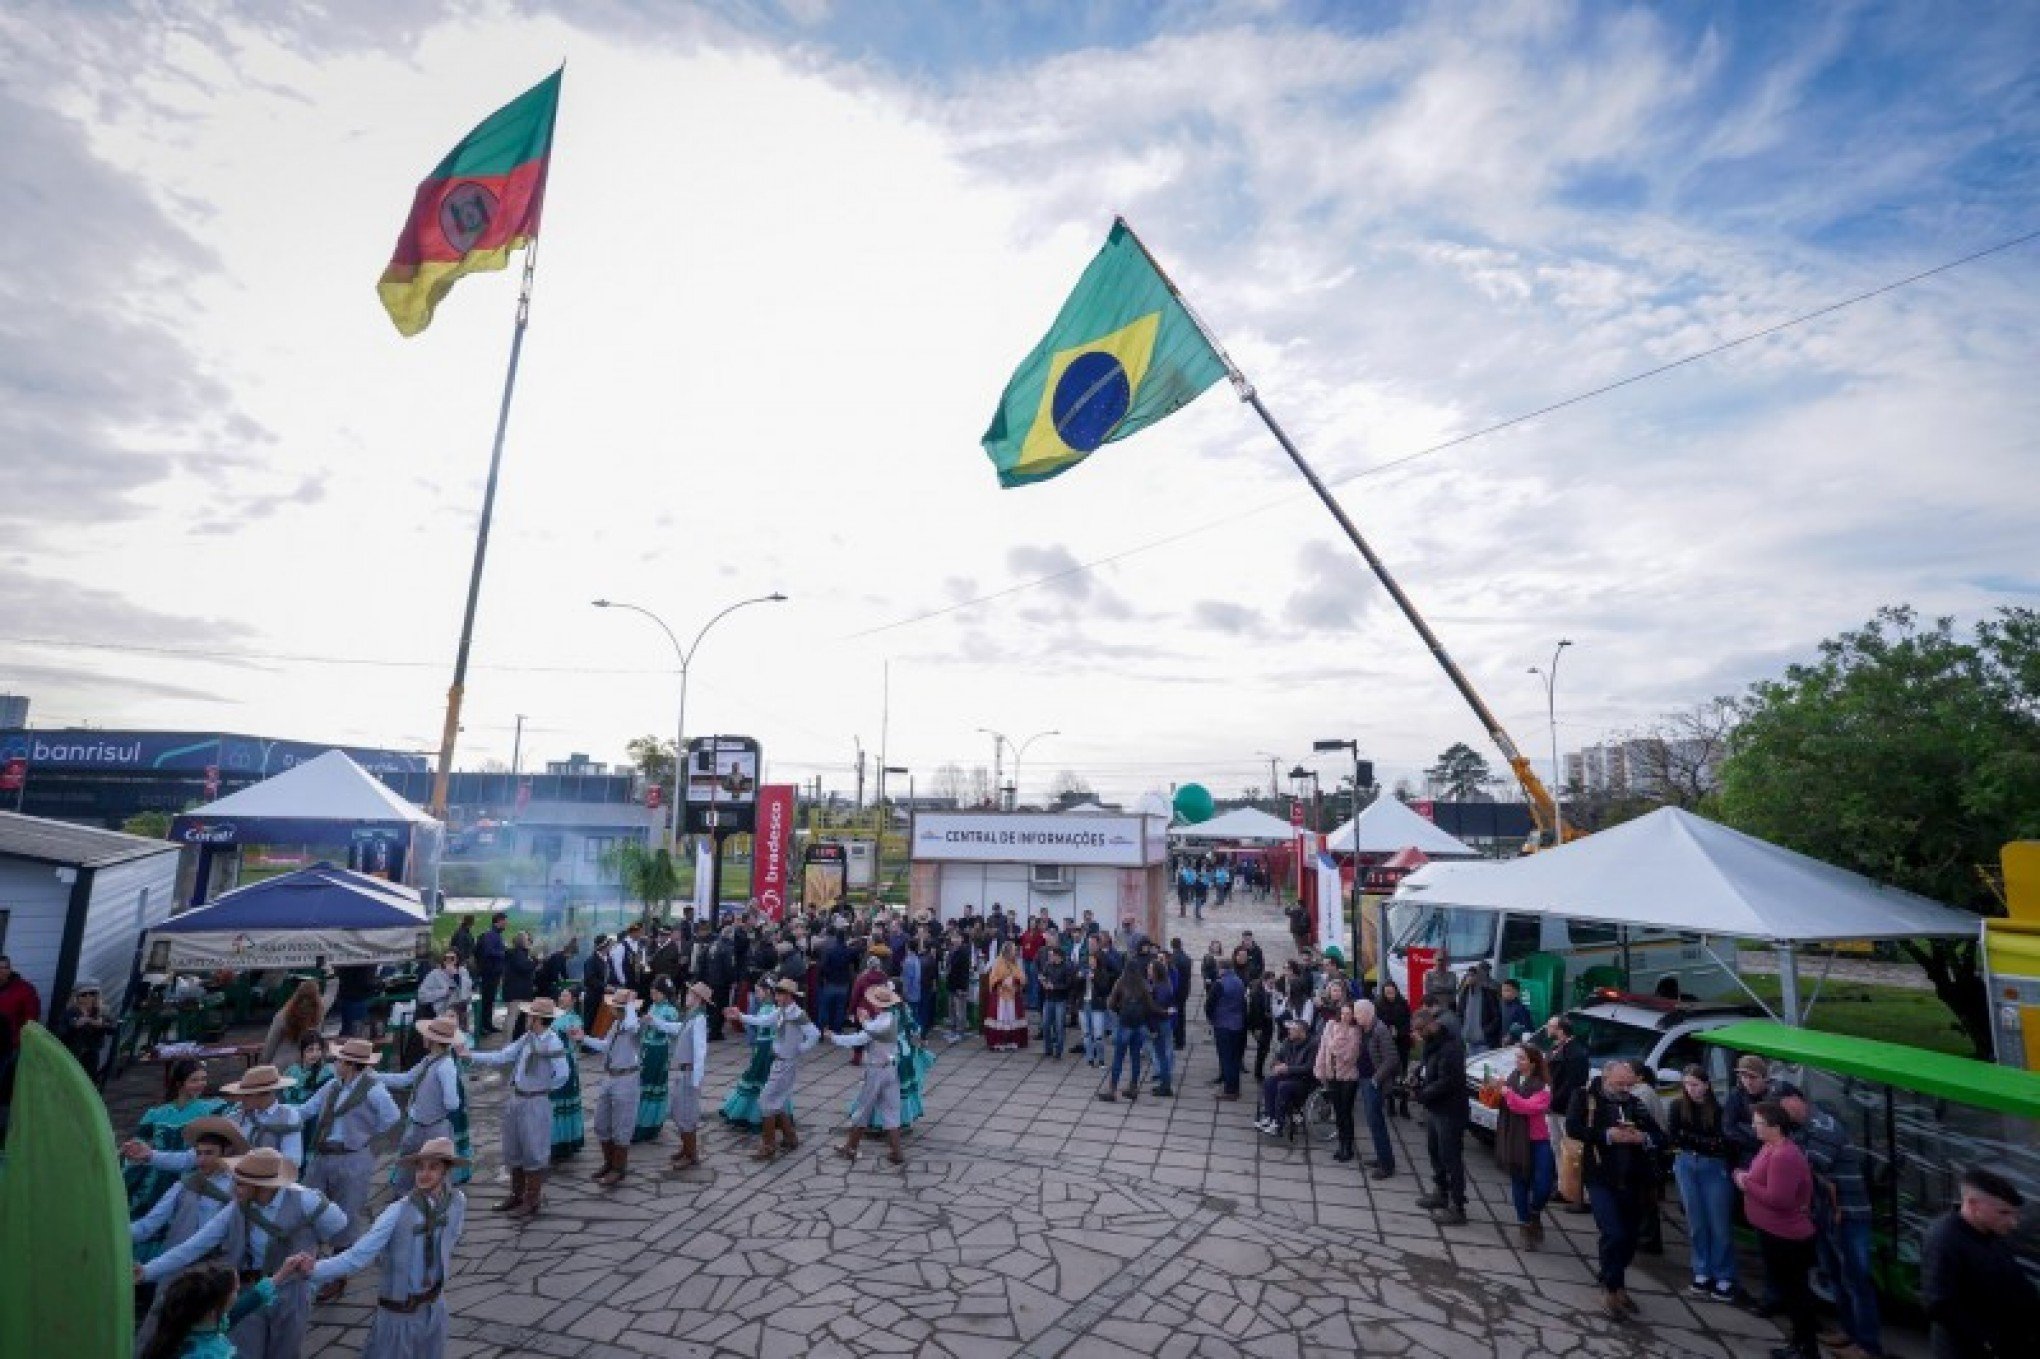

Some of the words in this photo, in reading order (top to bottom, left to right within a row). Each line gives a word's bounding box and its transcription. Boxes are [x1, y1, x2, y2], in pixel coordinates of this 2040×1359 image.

[33, 740, 141, 763] banrisul
[765, 800, 782, 883] bradesco
[945, 830, 997, 844] CENTRAL
[1000, 831, 1016, 845] DE
[1018, 831, 1105, 849] INFORMAÇÕES
